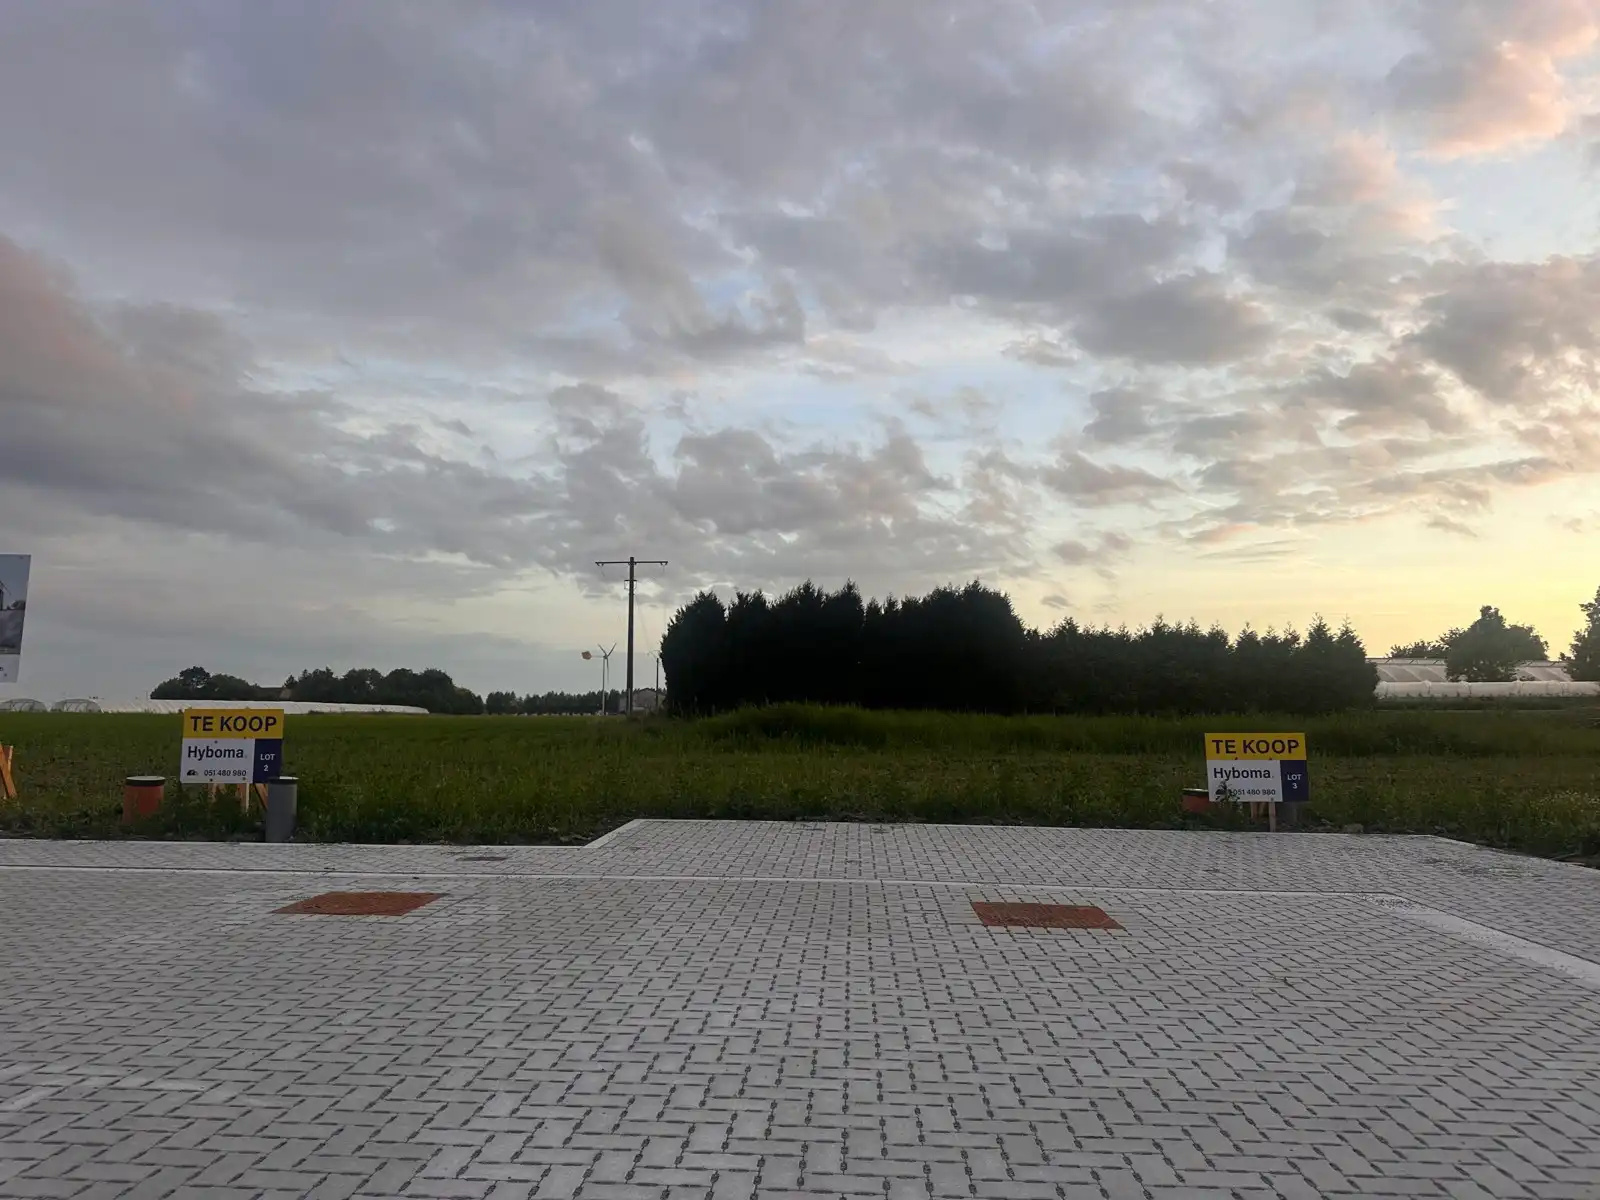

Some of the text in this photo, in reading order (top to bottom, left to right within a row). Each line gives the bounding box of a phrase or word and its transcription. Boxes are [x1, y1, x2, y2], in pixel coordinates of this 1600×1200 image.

[190, 716, 277, 732] TE KOOP
[1212, 739, 1299, 754] TE KOOP
[260, 753, 275, 761] LOT
[263, 764, 269, 772] 2
[204, 769, 247, 777] 051 480 980
[1292, 782, 1298, 790] 3
[1246, 788, 1261, 796] 480
